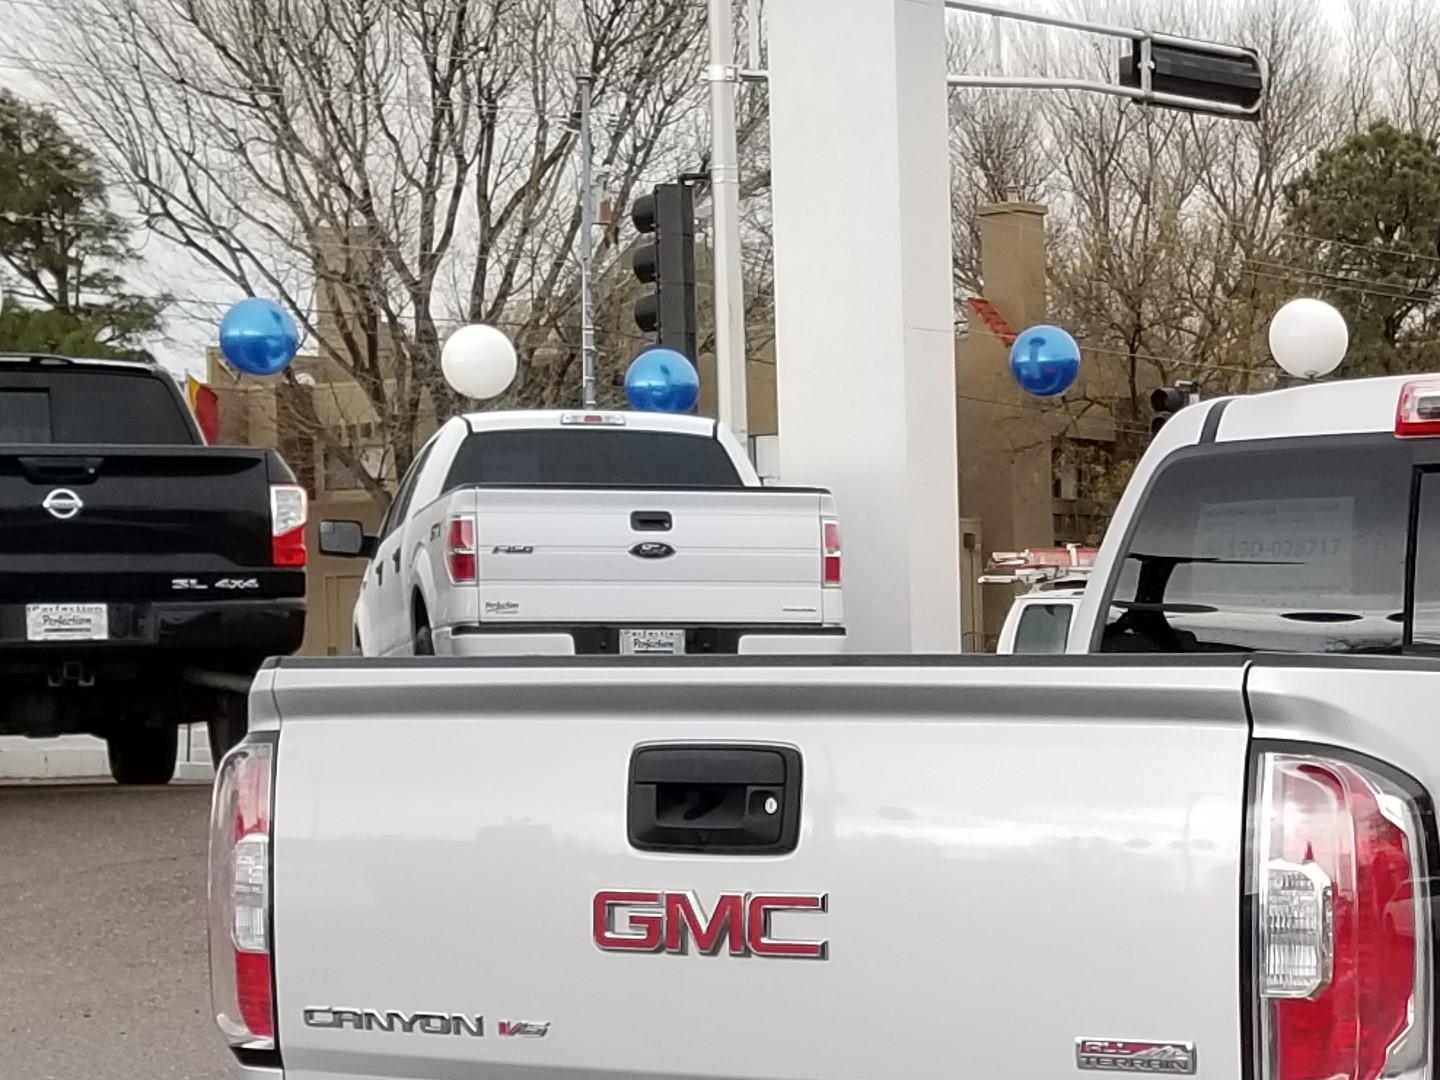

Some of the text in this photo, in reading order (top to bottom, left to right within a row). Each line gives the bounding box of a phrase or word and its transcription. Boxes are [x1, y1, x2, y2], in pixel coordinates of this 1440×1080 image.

[172, 579, 208, 589] SL
[593, 889, 828, 960] GMC
[303, 1006, 484, 1037] CANYON
[1081, 1056, 1190, 1073] TERRAIN
